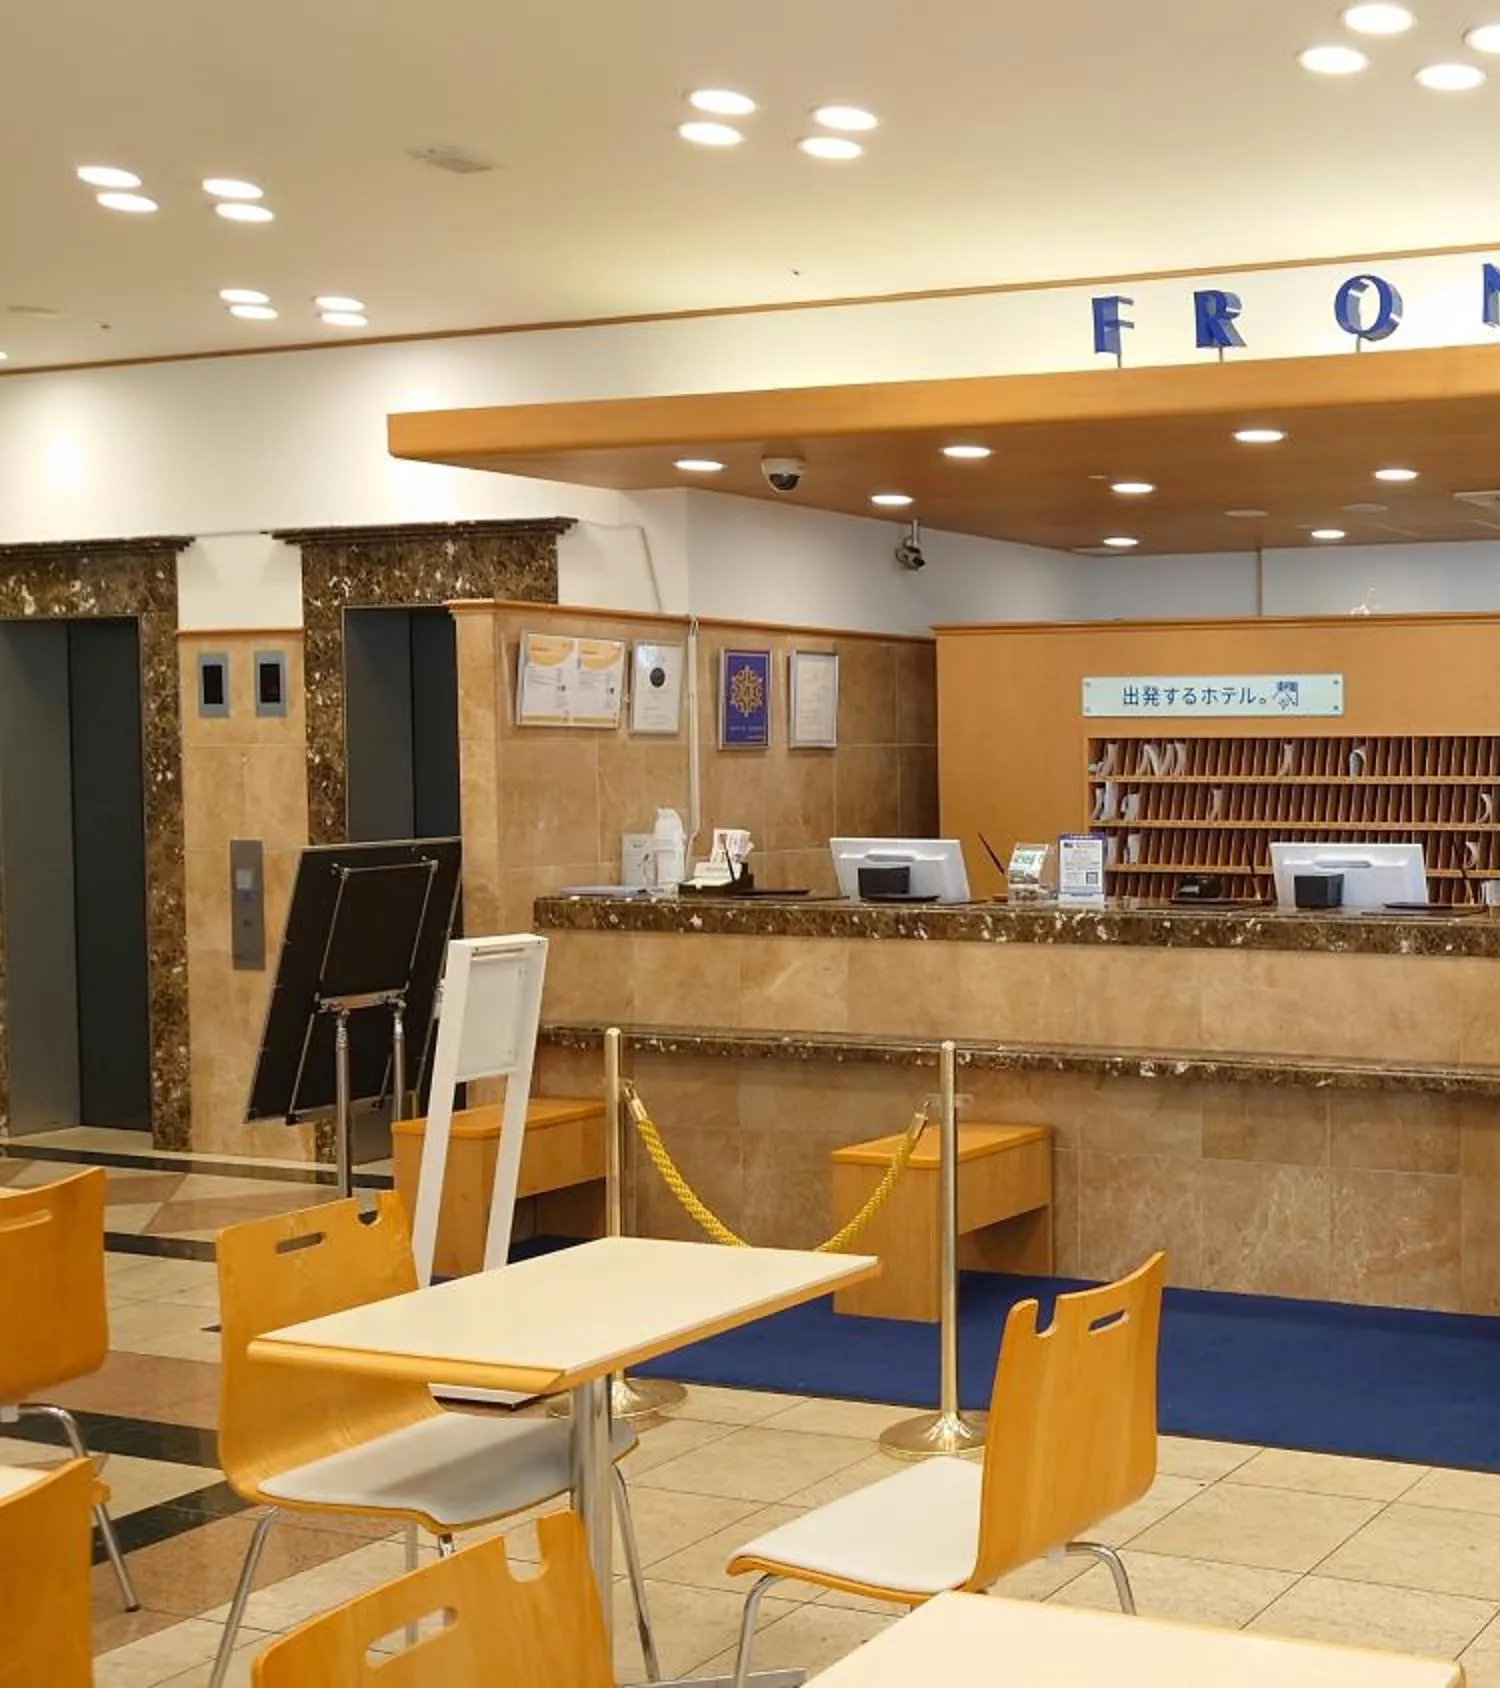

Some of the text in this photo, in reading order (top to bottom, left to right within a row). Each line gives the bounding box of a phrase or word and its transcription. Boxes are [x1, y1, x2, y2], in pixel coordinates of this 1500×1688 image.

[1122, 684, 1268, 706] 出発するホテル。
